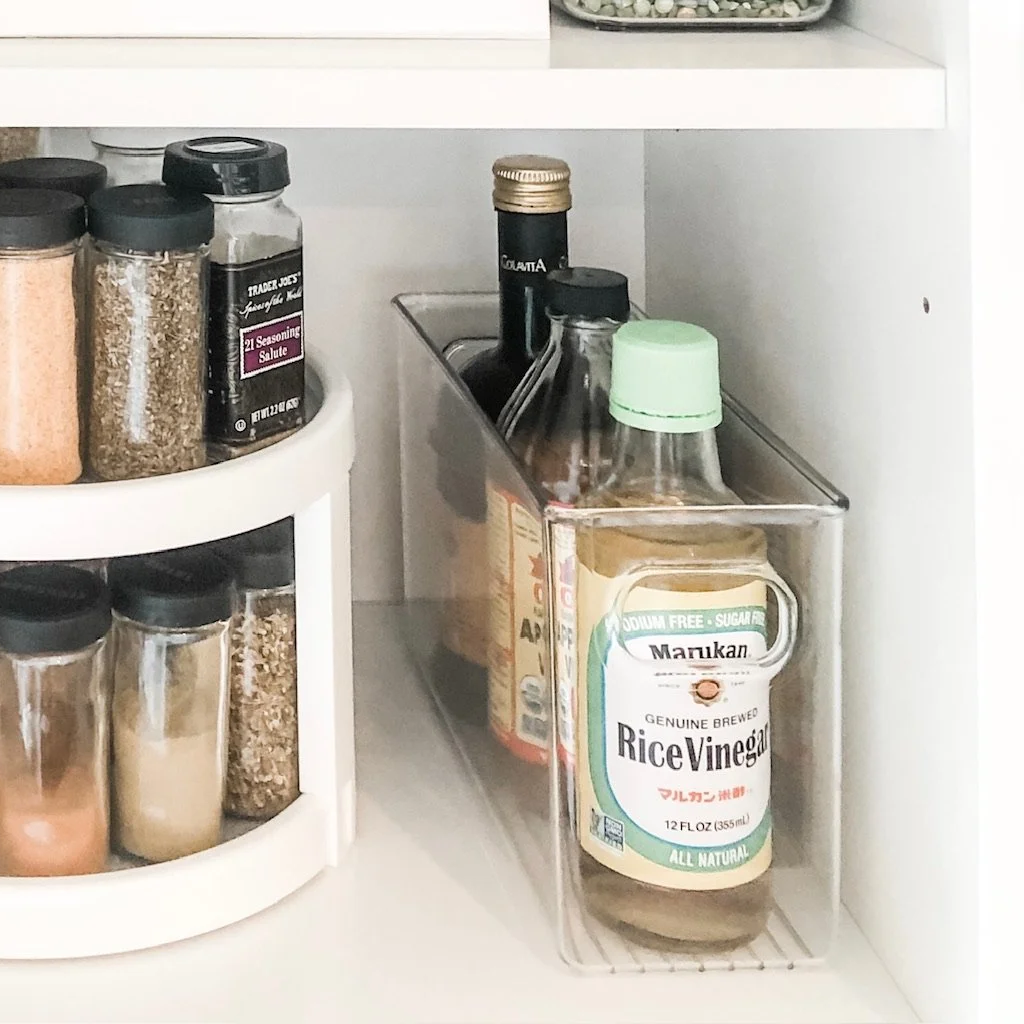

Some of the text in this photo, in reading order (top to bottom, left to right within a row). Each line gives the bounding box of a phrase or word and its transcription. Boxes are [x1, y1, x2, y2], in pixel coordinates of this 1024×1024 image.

[248, 280, 278, 298] TRADER
[245, 326, 301, 352] 21 Seasoning
[259, 346, 288, 364] Salute
[670, 614, 704, 629] FREE
[716, 612, 751, 627] SUGAR
[649, 642, 748, 660] Marukan
[645, 708, 759, 730] GENUINE BREWED
[618, 722, 683, 768] Rice
[665, 820, 680, 831] 12
[696, 821, 712, 832] OZ
[670, 846, 749, 867] ALL NATURAL
